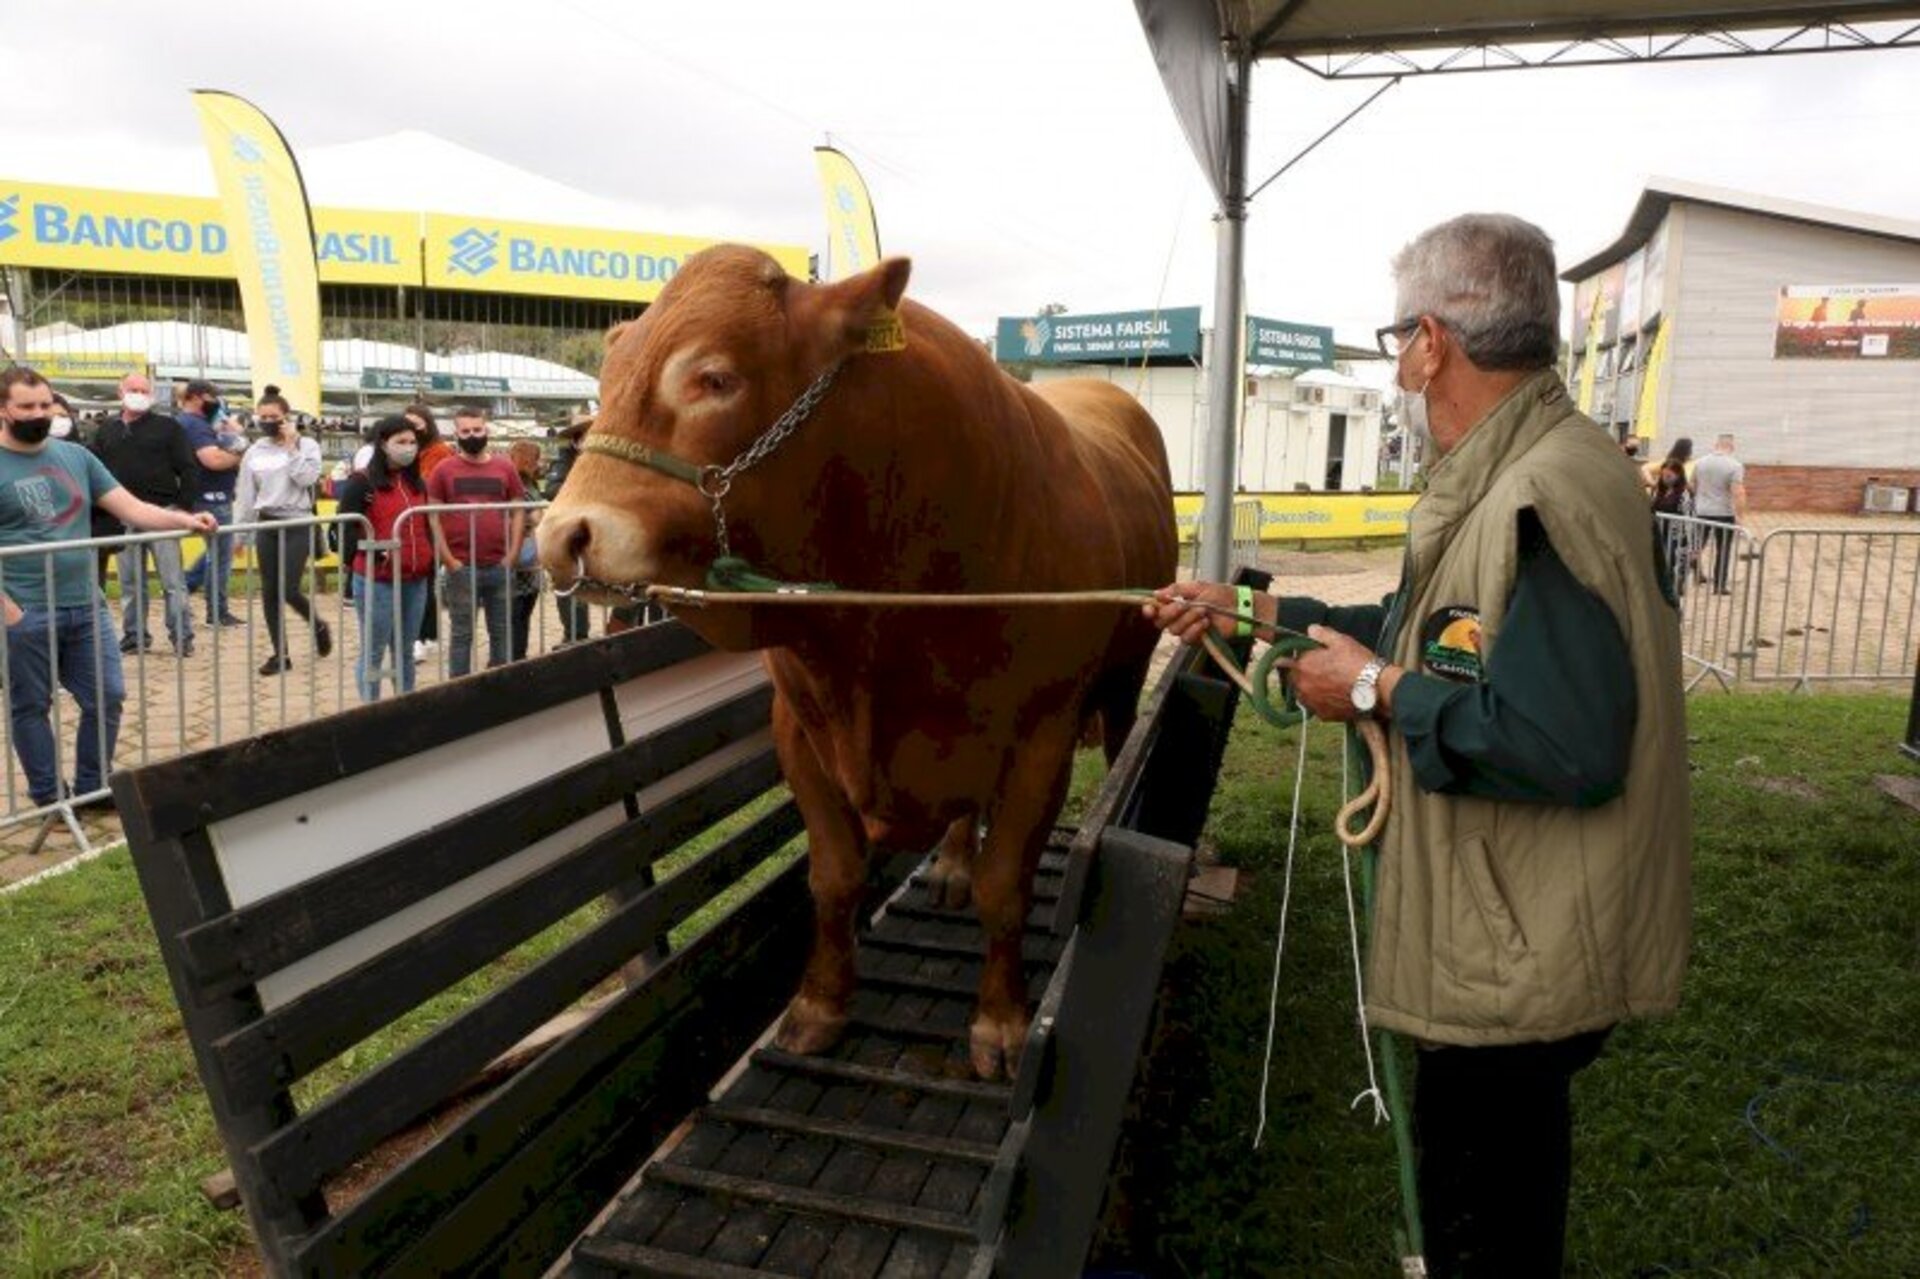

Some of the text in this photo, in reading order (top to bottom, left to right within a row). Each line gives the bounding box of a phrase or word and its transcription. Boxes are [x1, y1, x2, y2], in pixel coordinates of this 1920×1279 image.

[33, 203, 400, 264] BANCO D ASIL
[509, 237, 679, 283] BANCO DO
[1055, 320, 1171, 339] SISTEMA FARSUL
